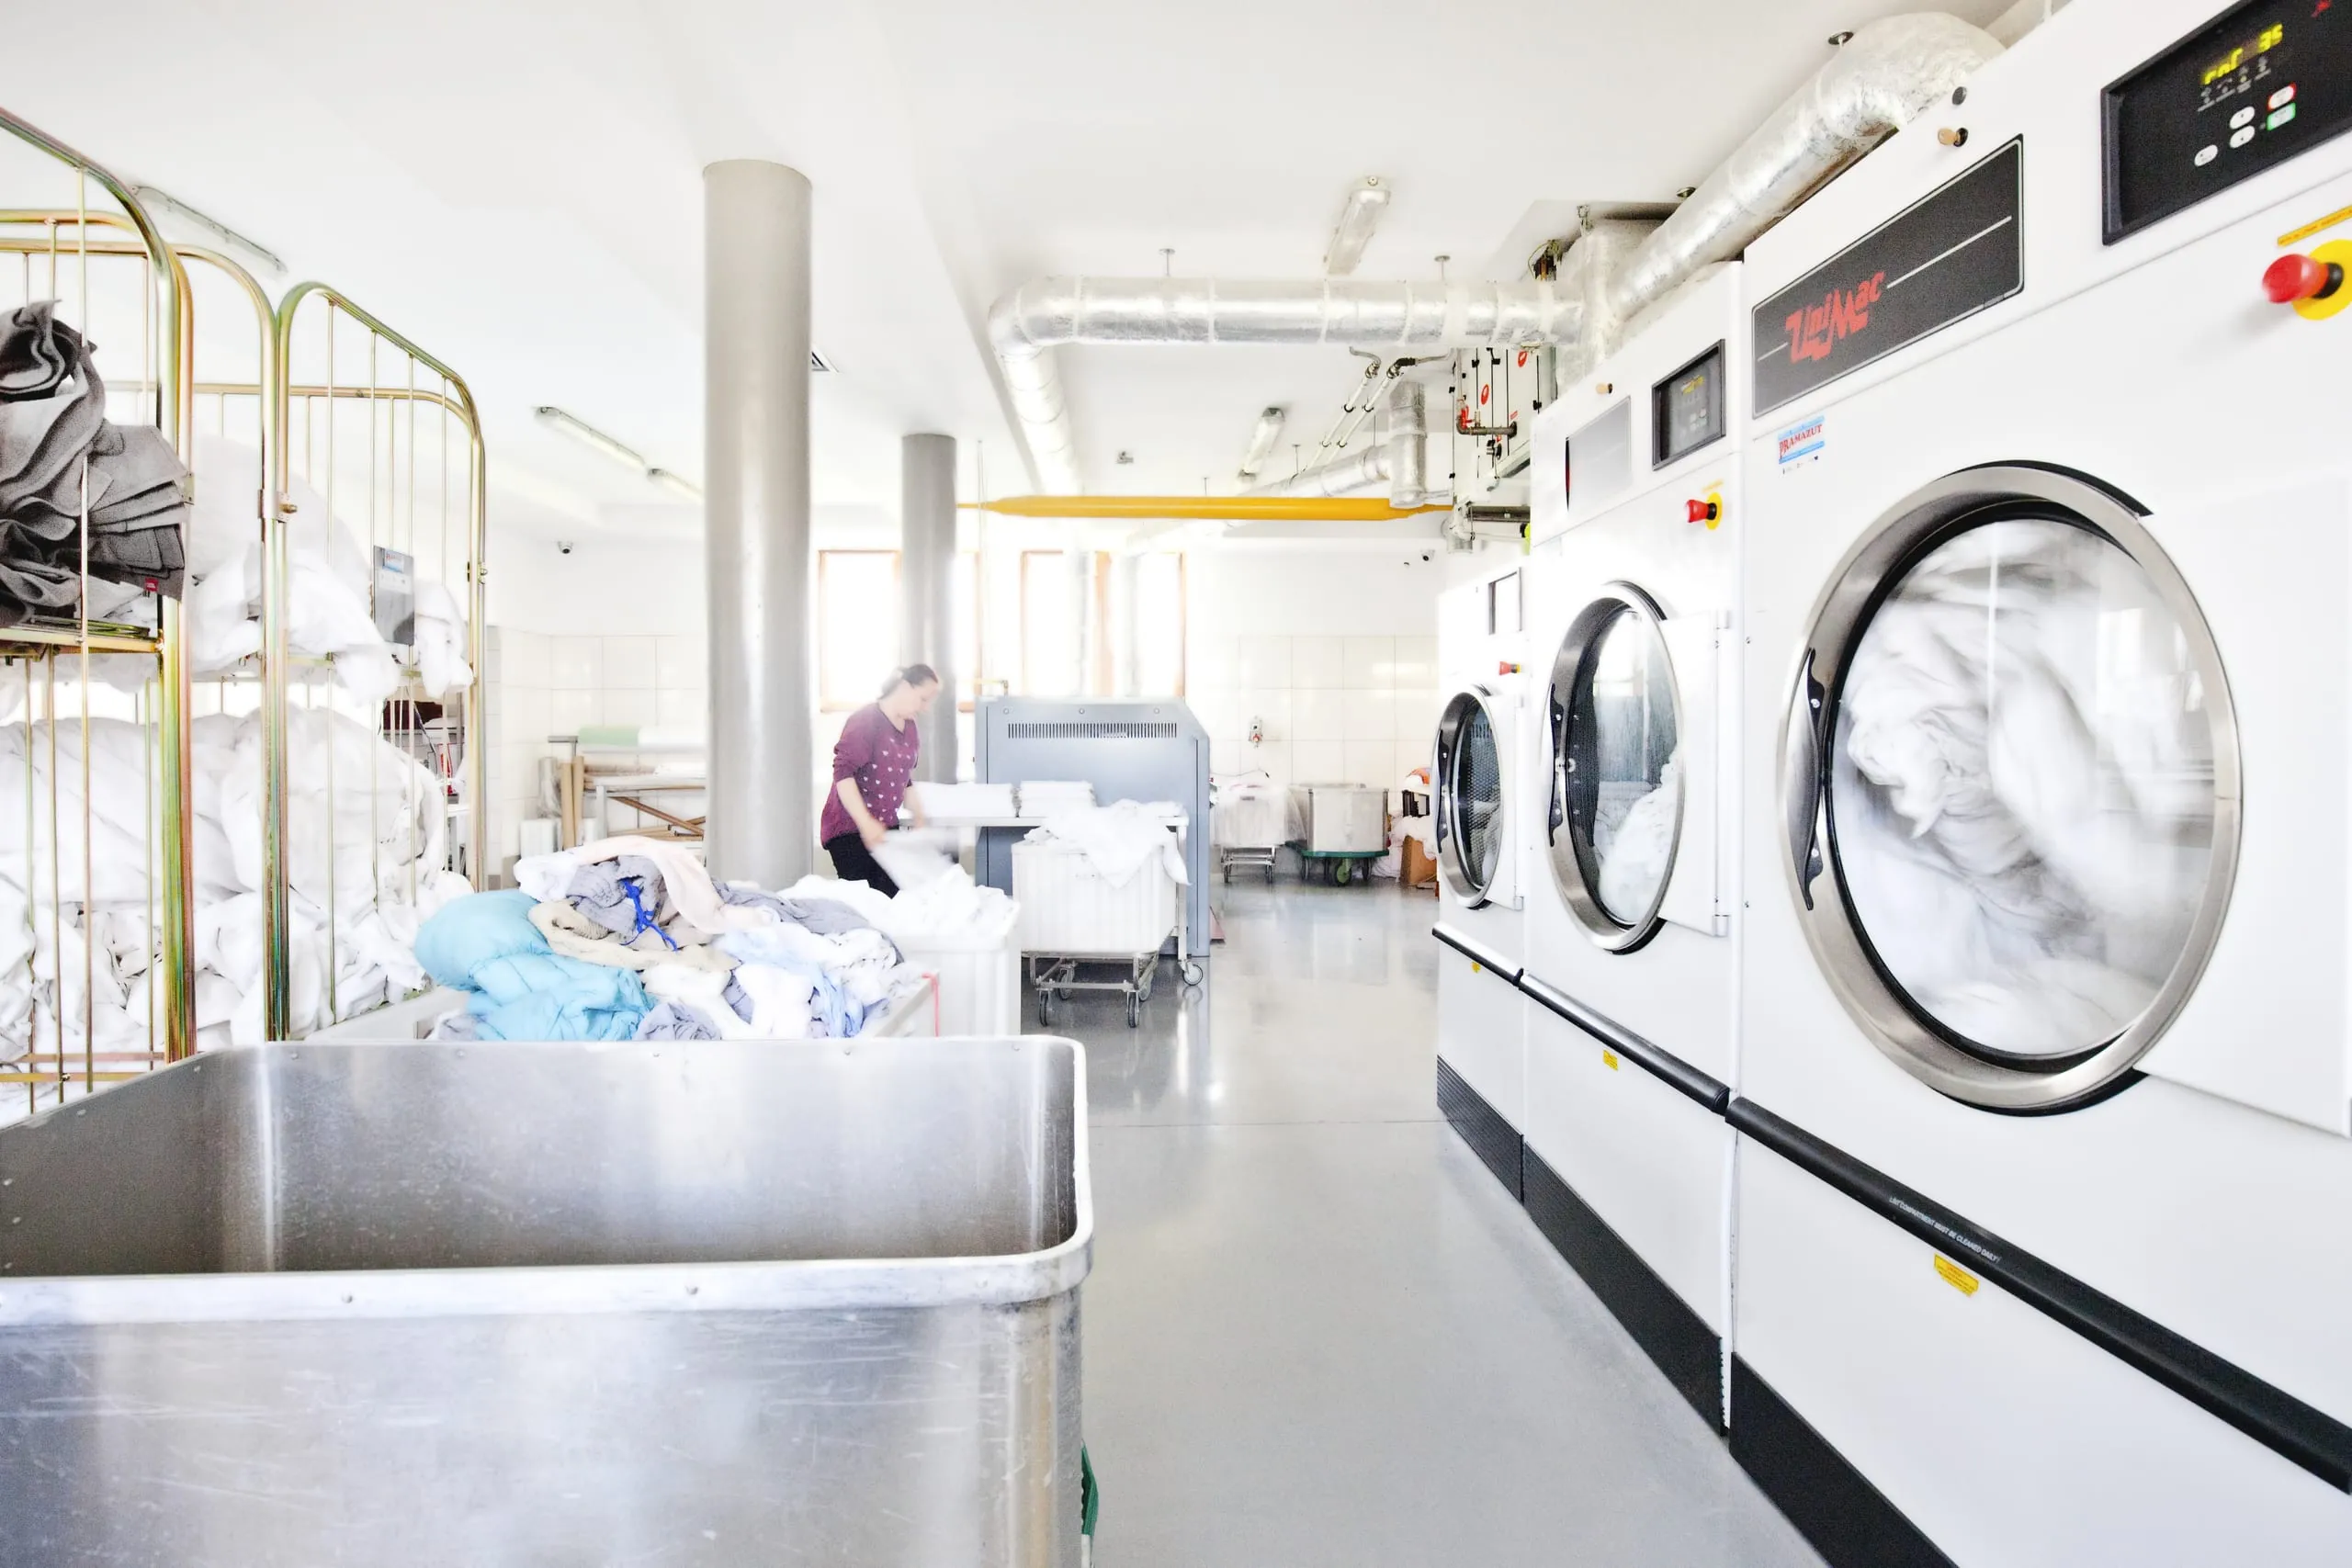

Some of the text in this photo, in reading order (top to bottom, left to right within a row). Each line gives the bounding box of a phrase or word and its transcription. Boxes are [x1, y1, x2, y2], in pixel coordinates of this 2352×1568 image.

[1786, 272, 1885, 363] UniMac
[1934, 1223, 1949, 1234] MUST
[1949, 1230, 1957, 1239] BE
[1956, 1235, 1982, 1253] CLEANED
